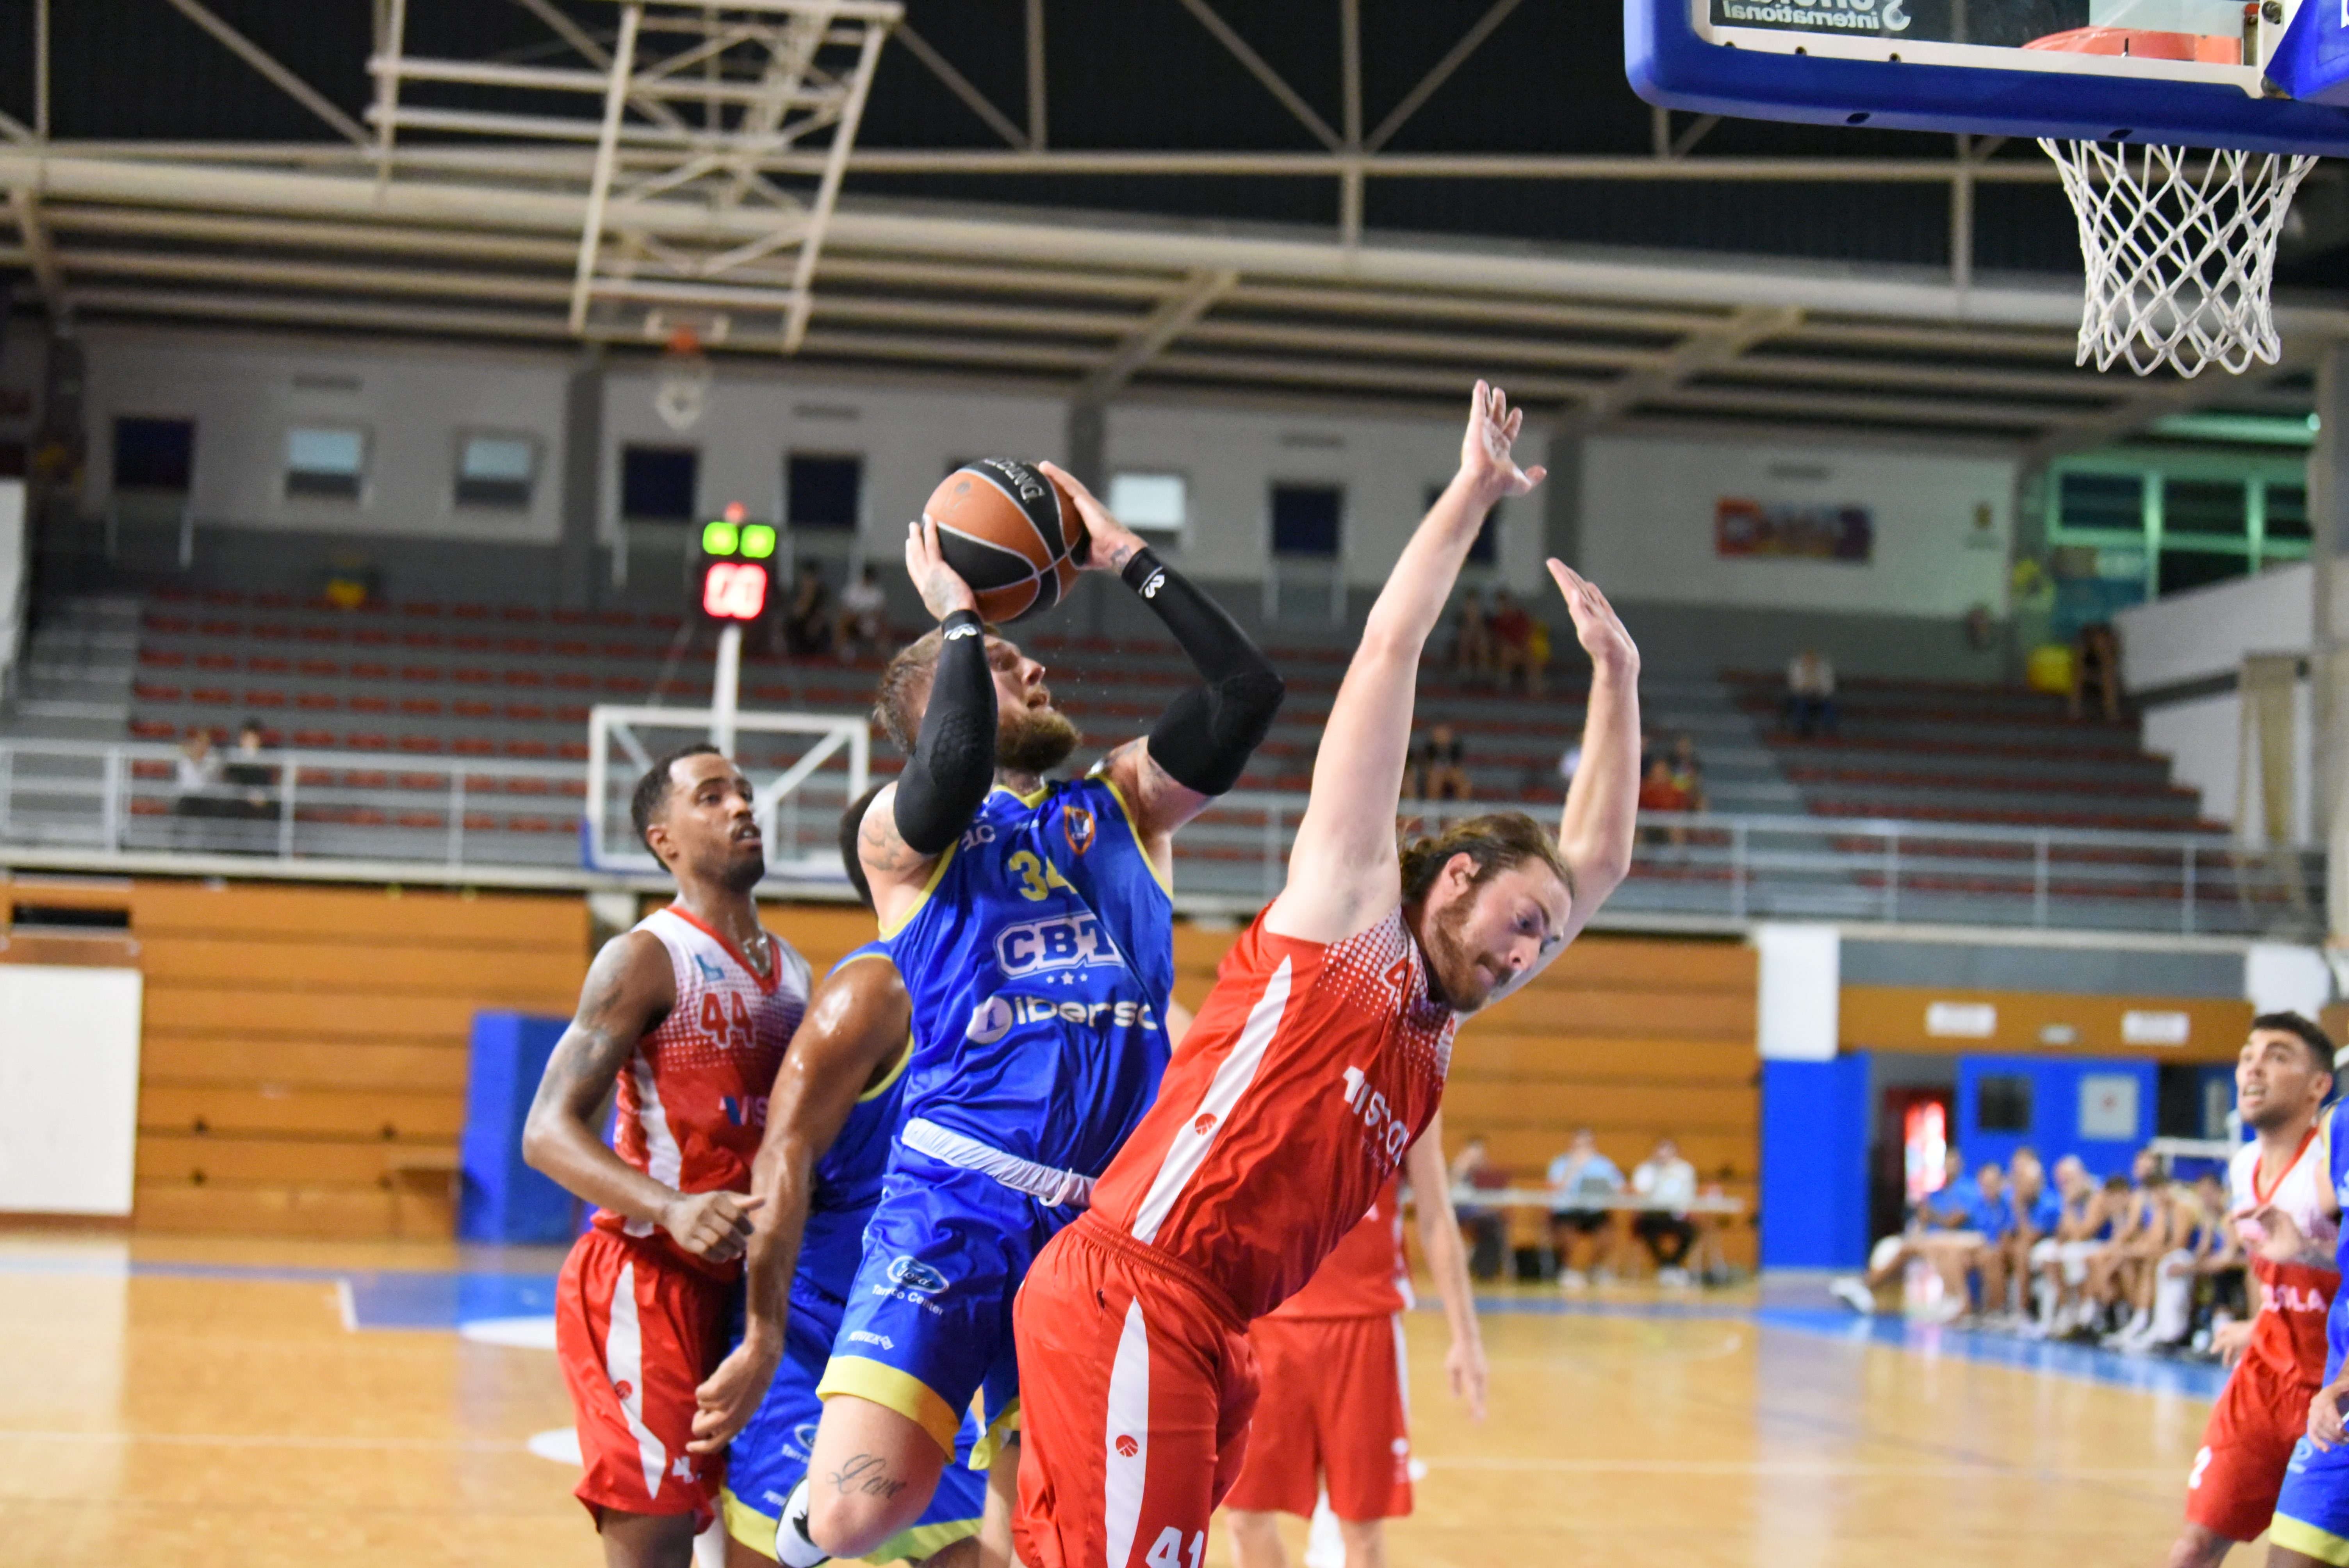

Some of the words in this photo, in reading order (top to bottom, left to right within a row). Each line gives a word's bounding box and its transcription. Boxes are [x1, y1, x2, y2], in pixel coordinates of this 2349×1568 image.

[700, 991, 756, 1049] 44
[907, 1292, 944, 1315] Center
[1146, 1526, 1204, 1568] 41
